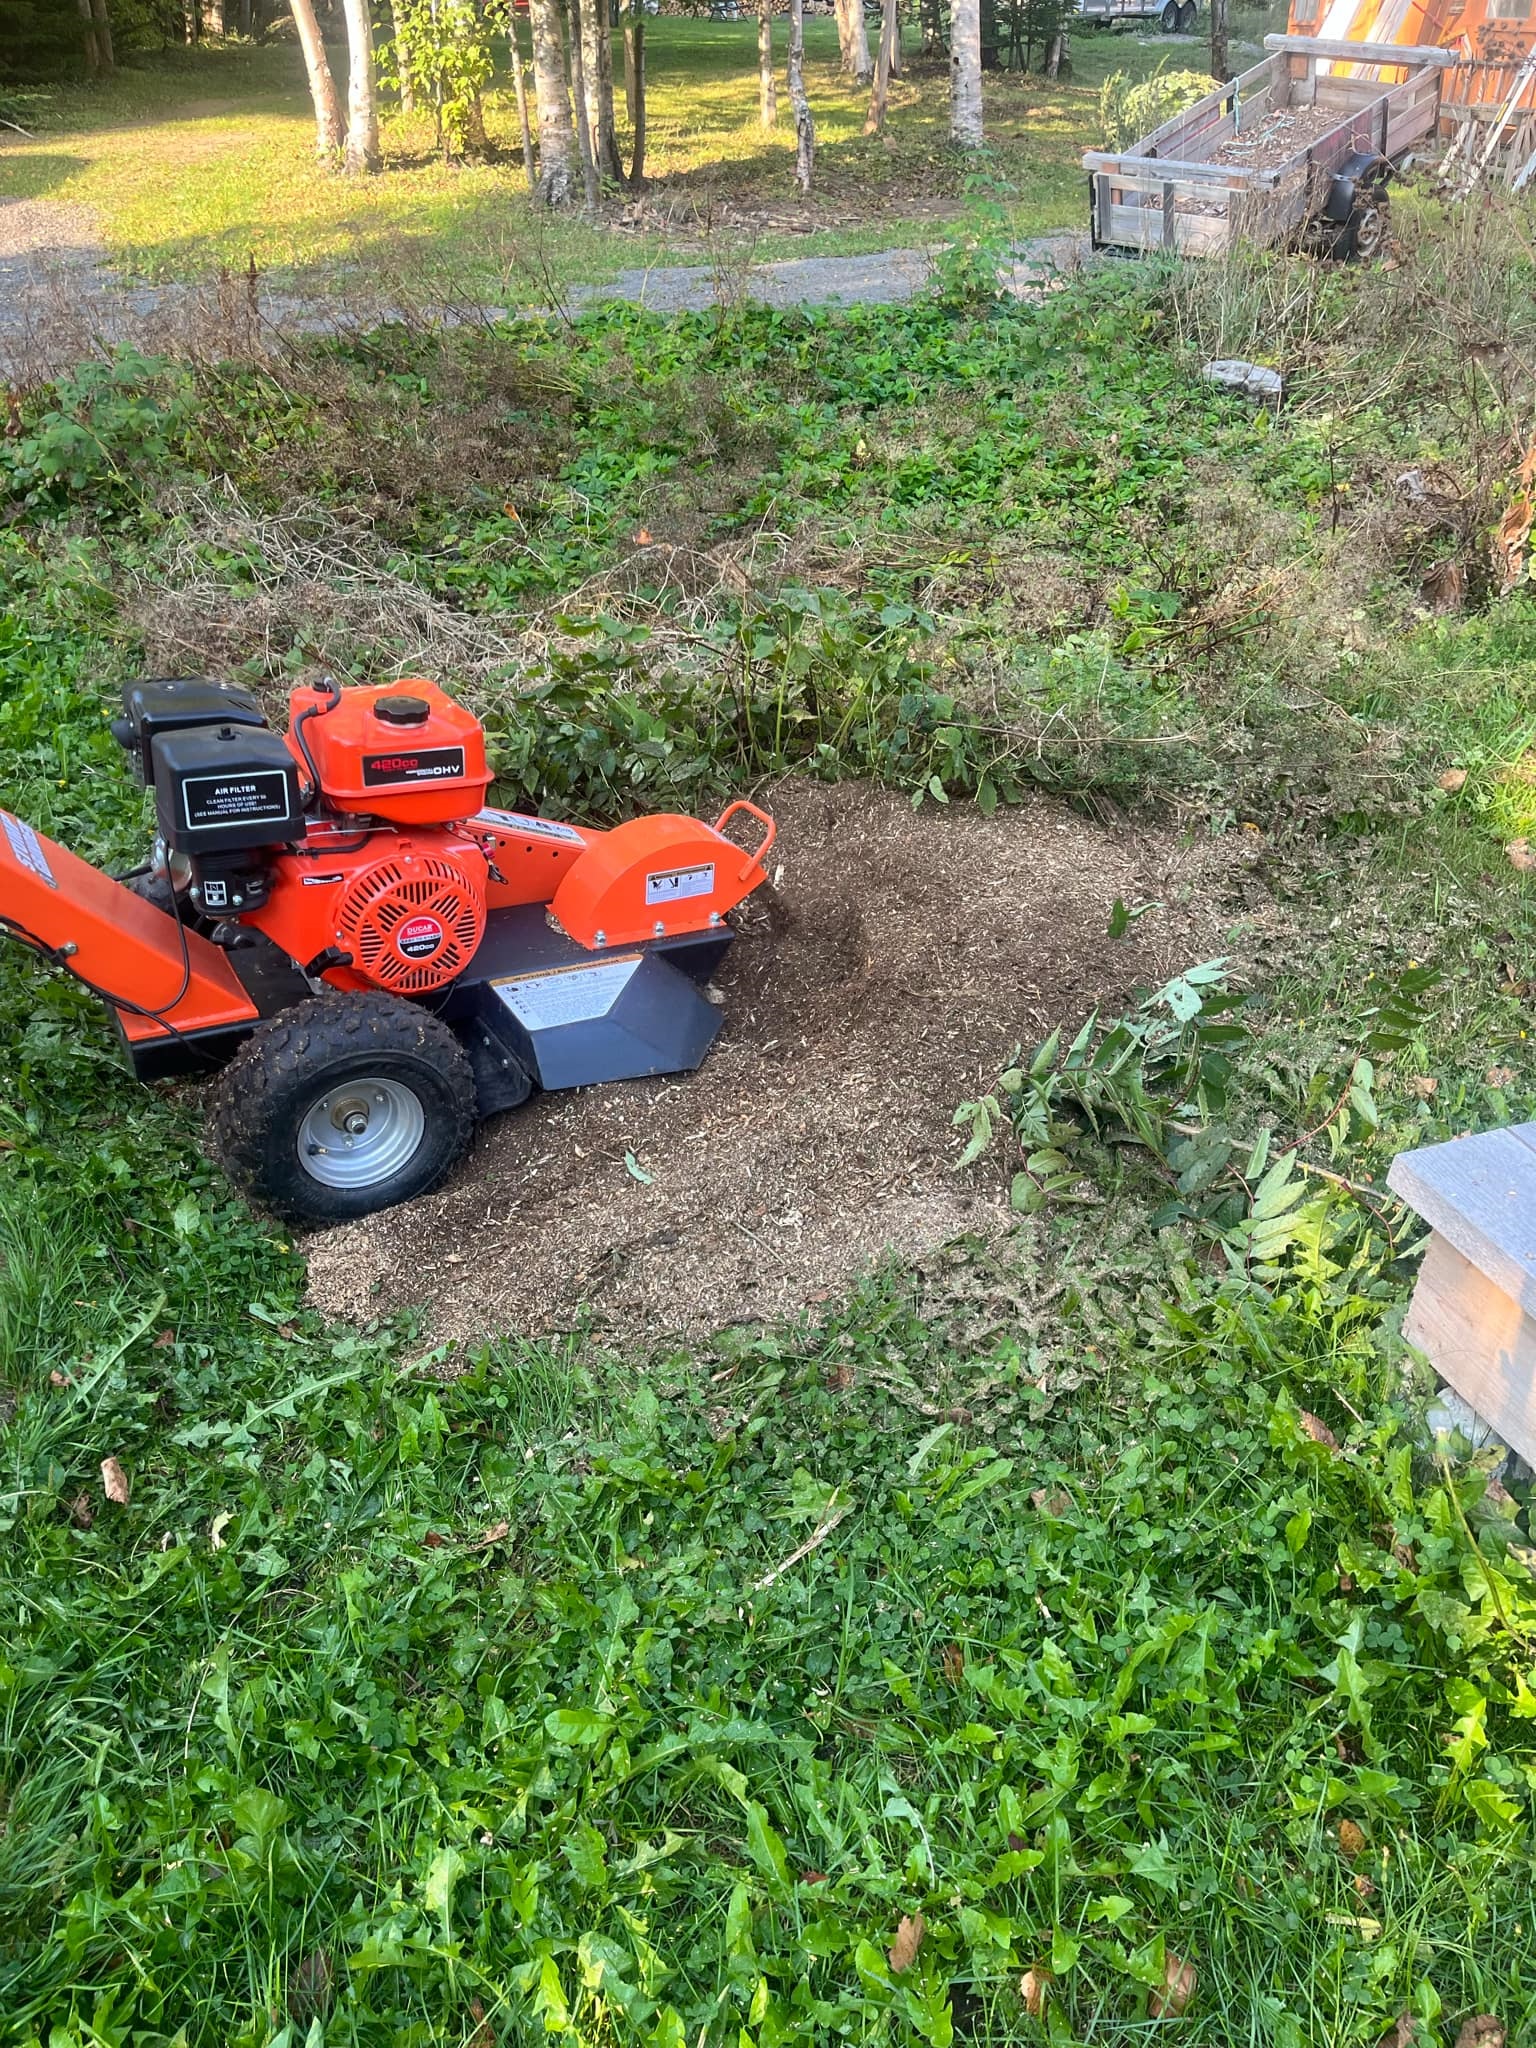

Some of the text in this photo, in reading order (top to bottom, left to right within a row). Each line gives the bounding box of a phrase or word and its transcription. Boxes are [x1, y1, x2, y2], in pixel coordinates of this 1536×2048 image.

[433, 765, 460, 775] OHV
[215, 785, 256, 795] AIR FILTER
[407, 924, 432, 936] DUCAR
